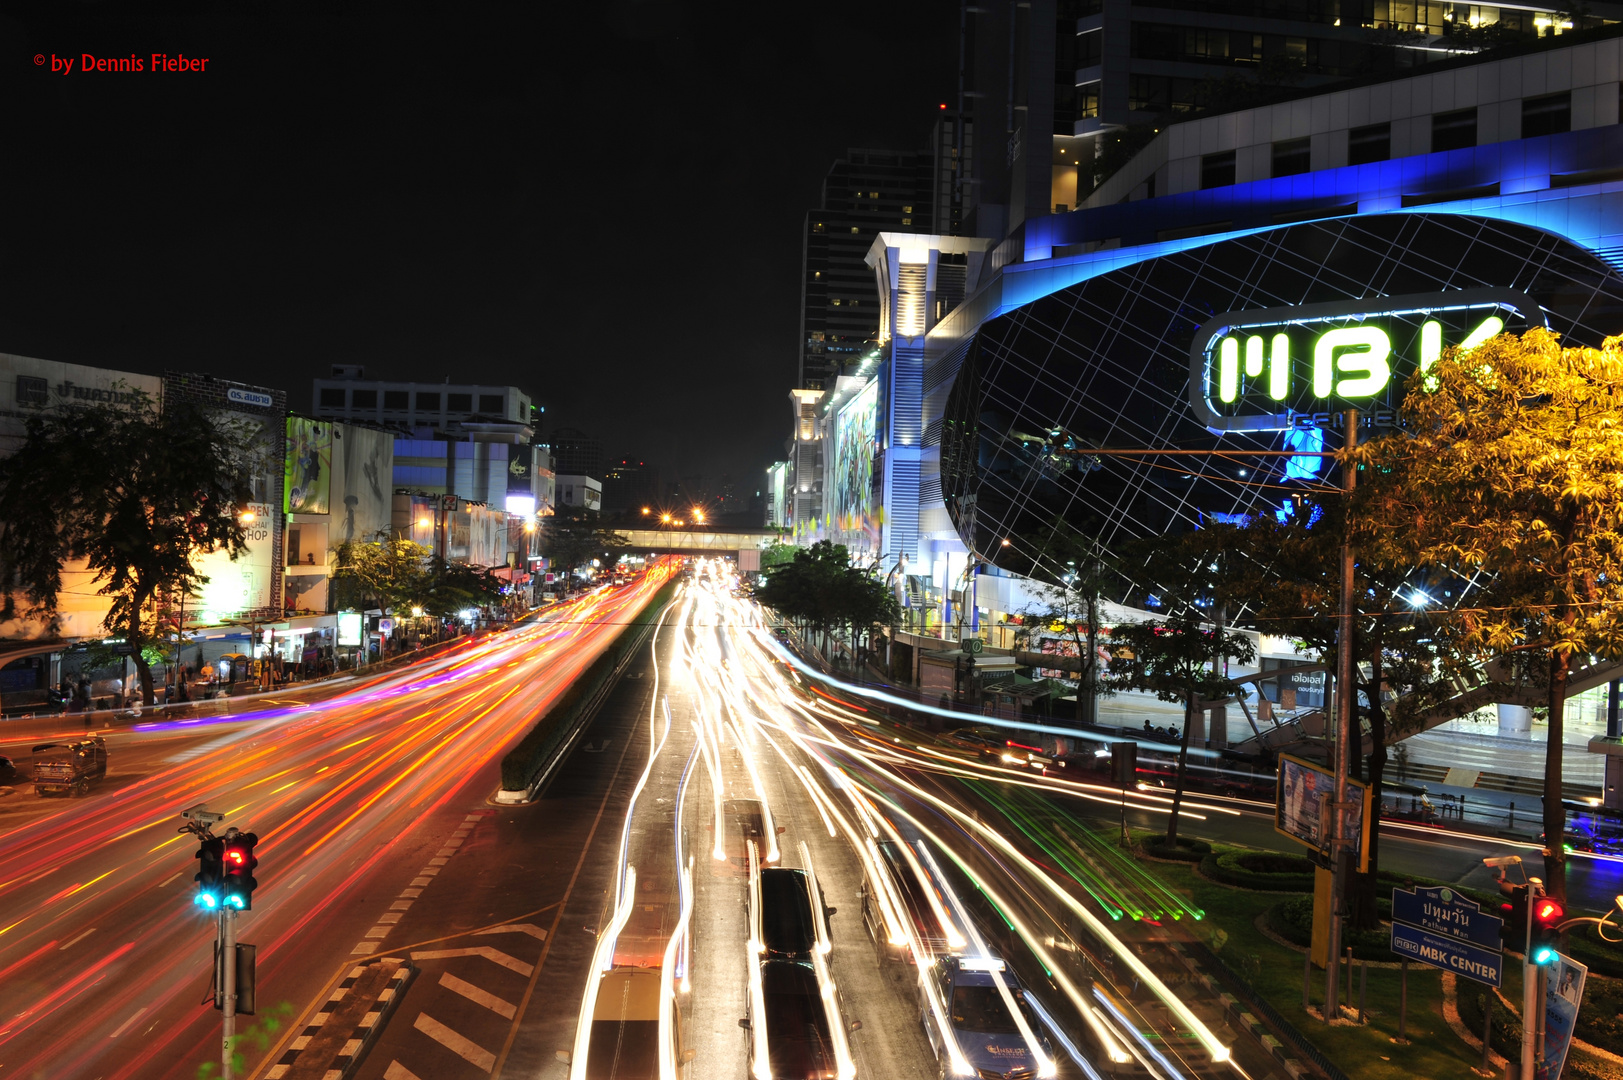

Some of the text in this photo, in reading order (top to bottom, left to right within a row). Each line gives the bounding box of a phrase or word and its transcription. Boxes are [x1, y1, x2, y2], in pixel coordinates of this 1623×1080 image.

[1219, 316, 1504, 404] MBK
[1423, 902, 1469, 927] ปทุมวัน
[1422, 919, 1469, 939] Pathum Wan
[1420, 945, 1497, 981] MBK CENTER
[223, 1040, 229, 1050] 2
